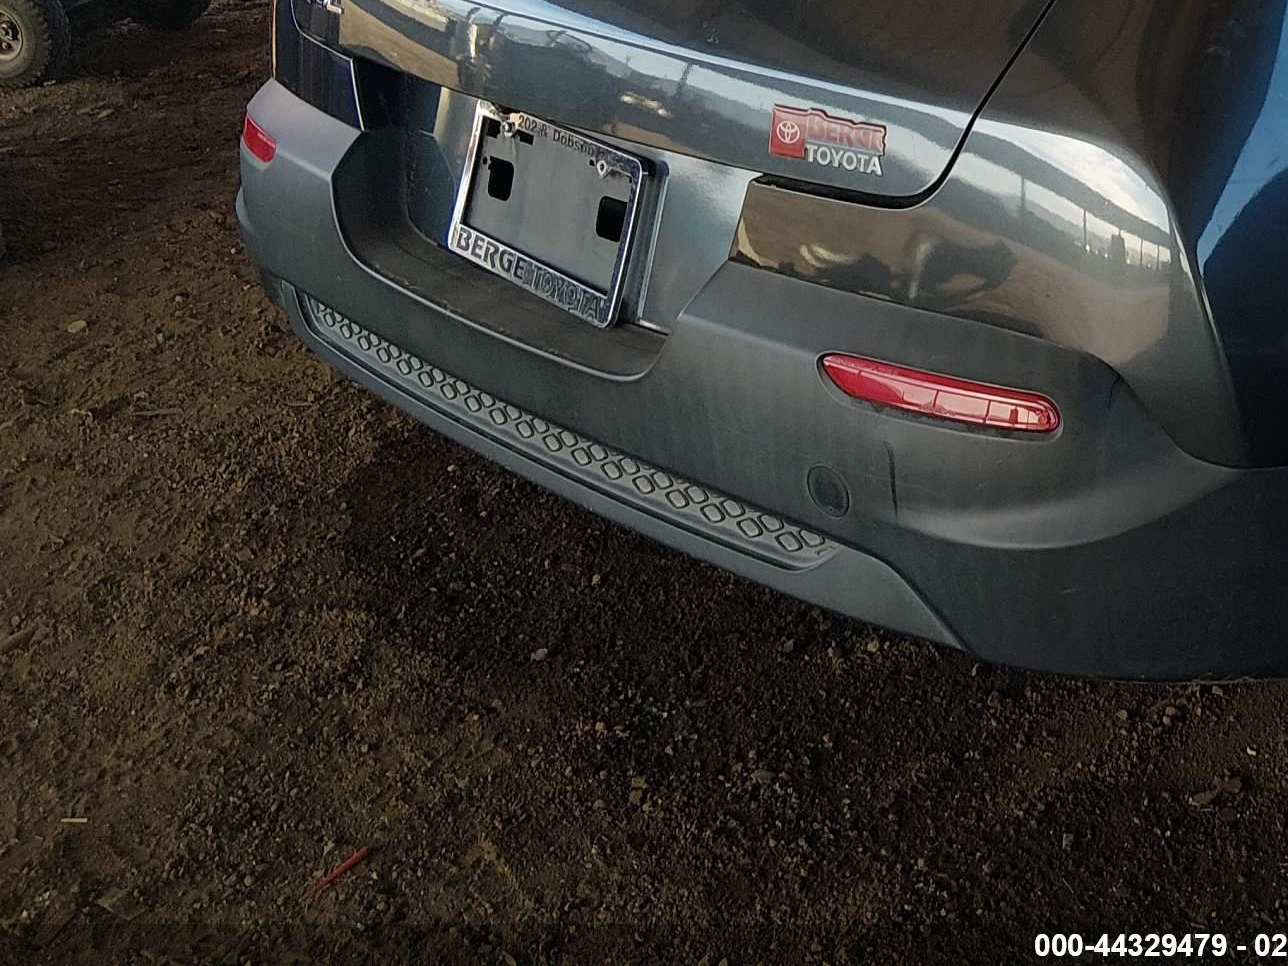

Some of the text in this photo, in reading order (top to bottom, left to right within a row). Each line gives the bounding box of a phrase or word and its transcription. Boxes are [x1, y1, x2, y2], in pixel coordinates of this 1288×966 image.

[806, 144, 883, 175] TOYOTA
[456, 228, 600, 320] BERGE TOYOTA
